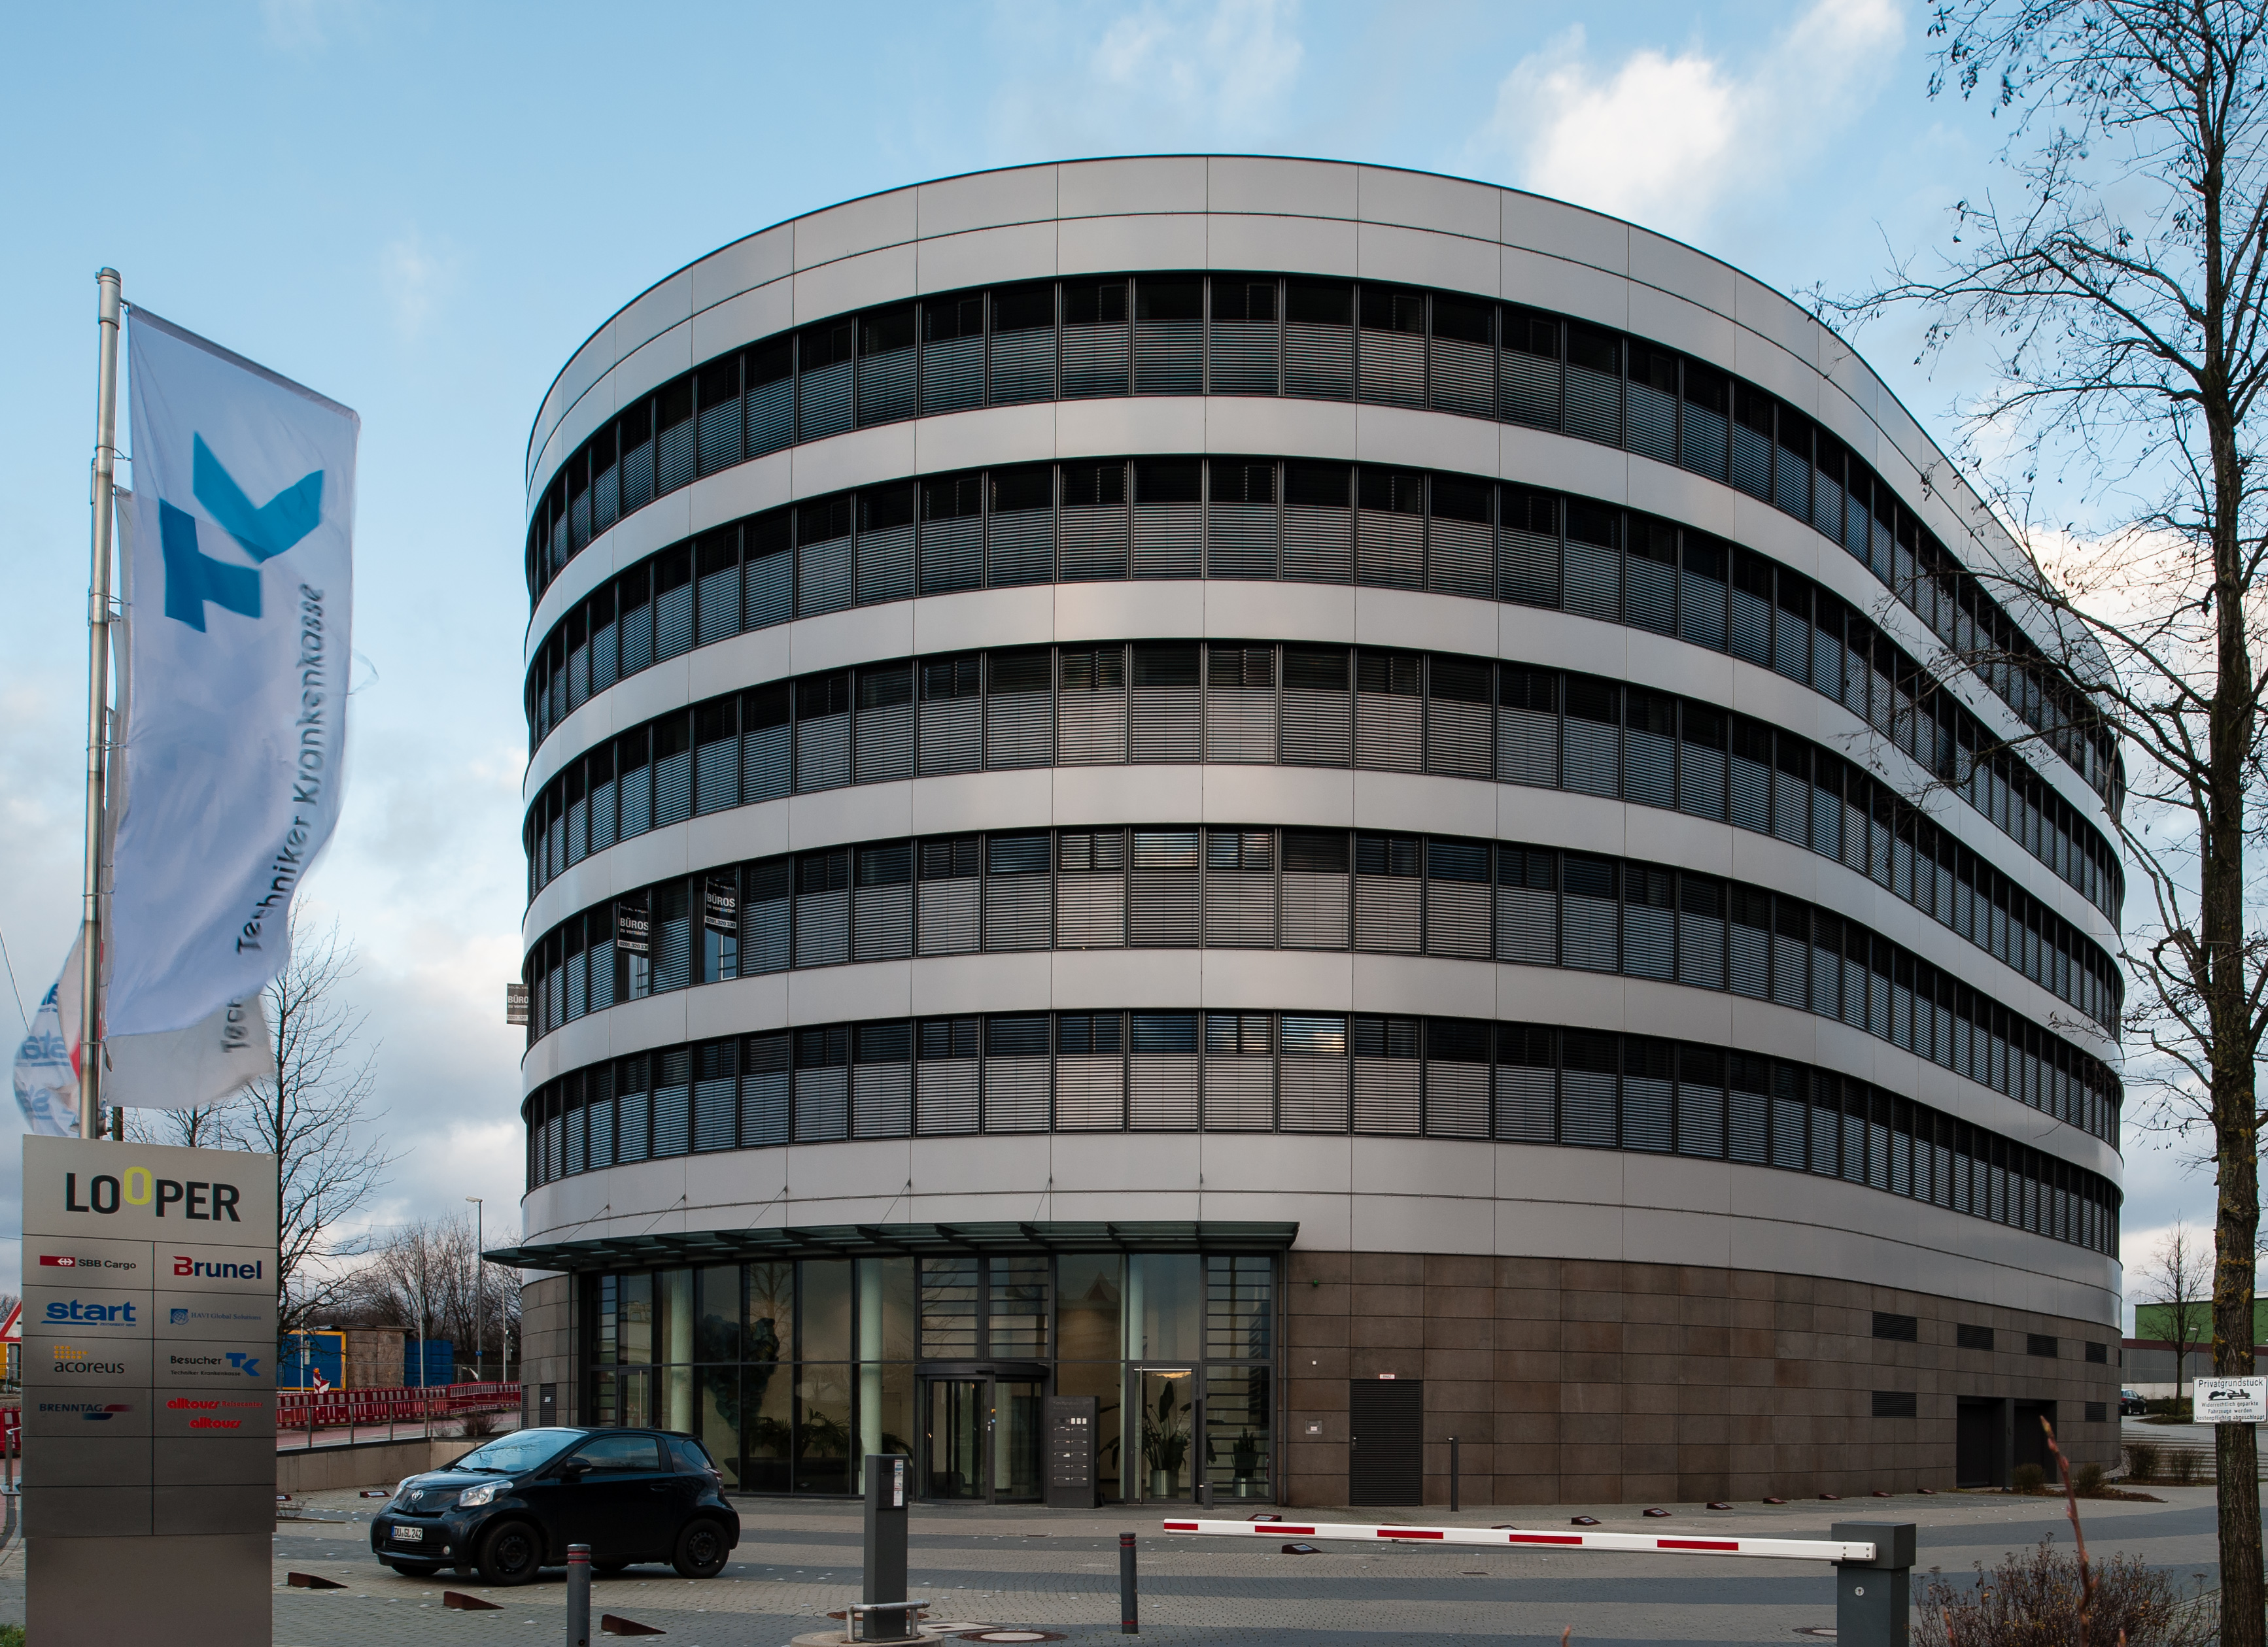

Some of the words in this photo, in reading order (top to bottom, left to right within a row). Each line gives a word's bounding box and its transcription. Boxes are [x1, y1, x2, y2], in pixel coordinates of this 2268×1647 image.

[236, 815, 311, 955] Techniker
[293, 583, 325, 806] Krankenkasse
[707, 893, 735, 908] BÜROS
[620, 917, 649, 930] BÜROS
[66, 1166, 241, 1222] LOOPER
[78, 1259, 102, 1267] SBB
[104, 1260, 137, 1270] Cargo
[173, 1255, 262, 1280] Brunel
[46, 1299, 136, 1322] start
[170, 1355, 222, 1365] Besucher
[54, 1361, 125, 1374] acoreus
[2199, 1378, 2263, 1389] Privatgrundstück
[39, 1403, 103, 1412] BRENNTAG
[166, 1397, 220, 1410] alltours
[189, 1417, 242, 1429] alltours
